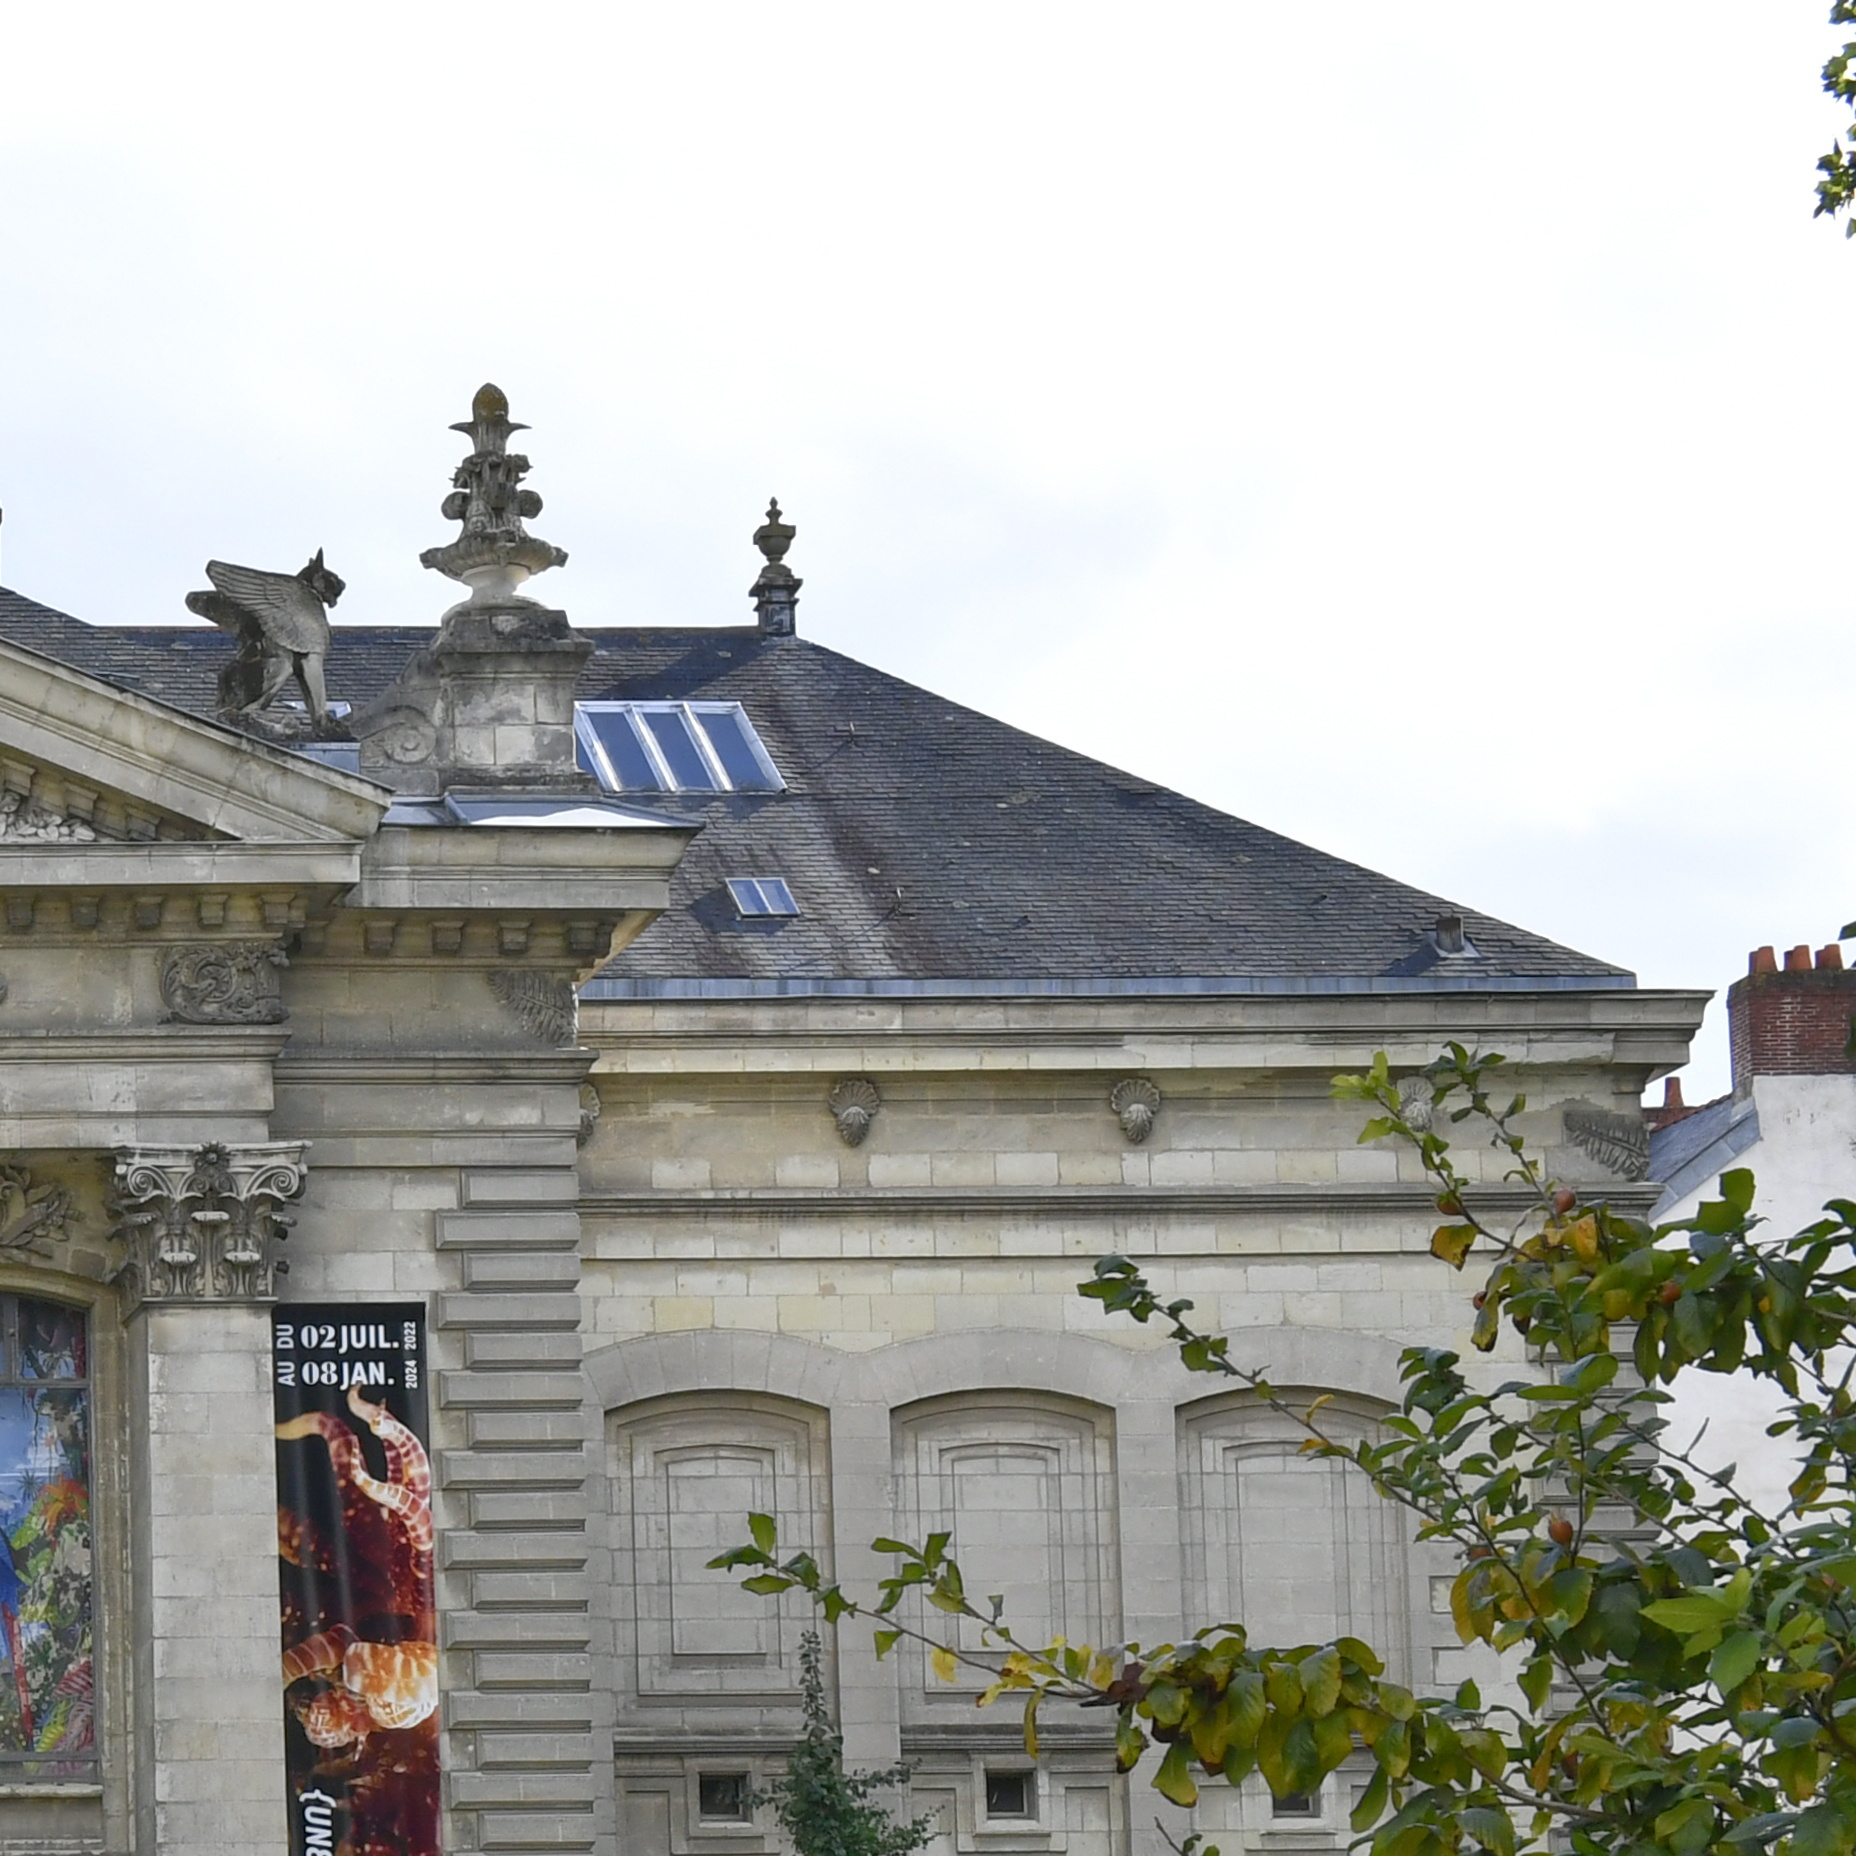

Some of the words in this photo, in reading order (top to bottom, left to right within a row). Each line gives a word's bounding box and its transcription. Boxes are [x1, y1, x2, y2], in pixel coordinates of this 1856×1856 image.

[276, 1324, 294, 1349] DU
[404, 1321, 416, 1350] 2022
[278, 1361, 295, 1386] AU
[405, 1360, 417, 1389] 2024
